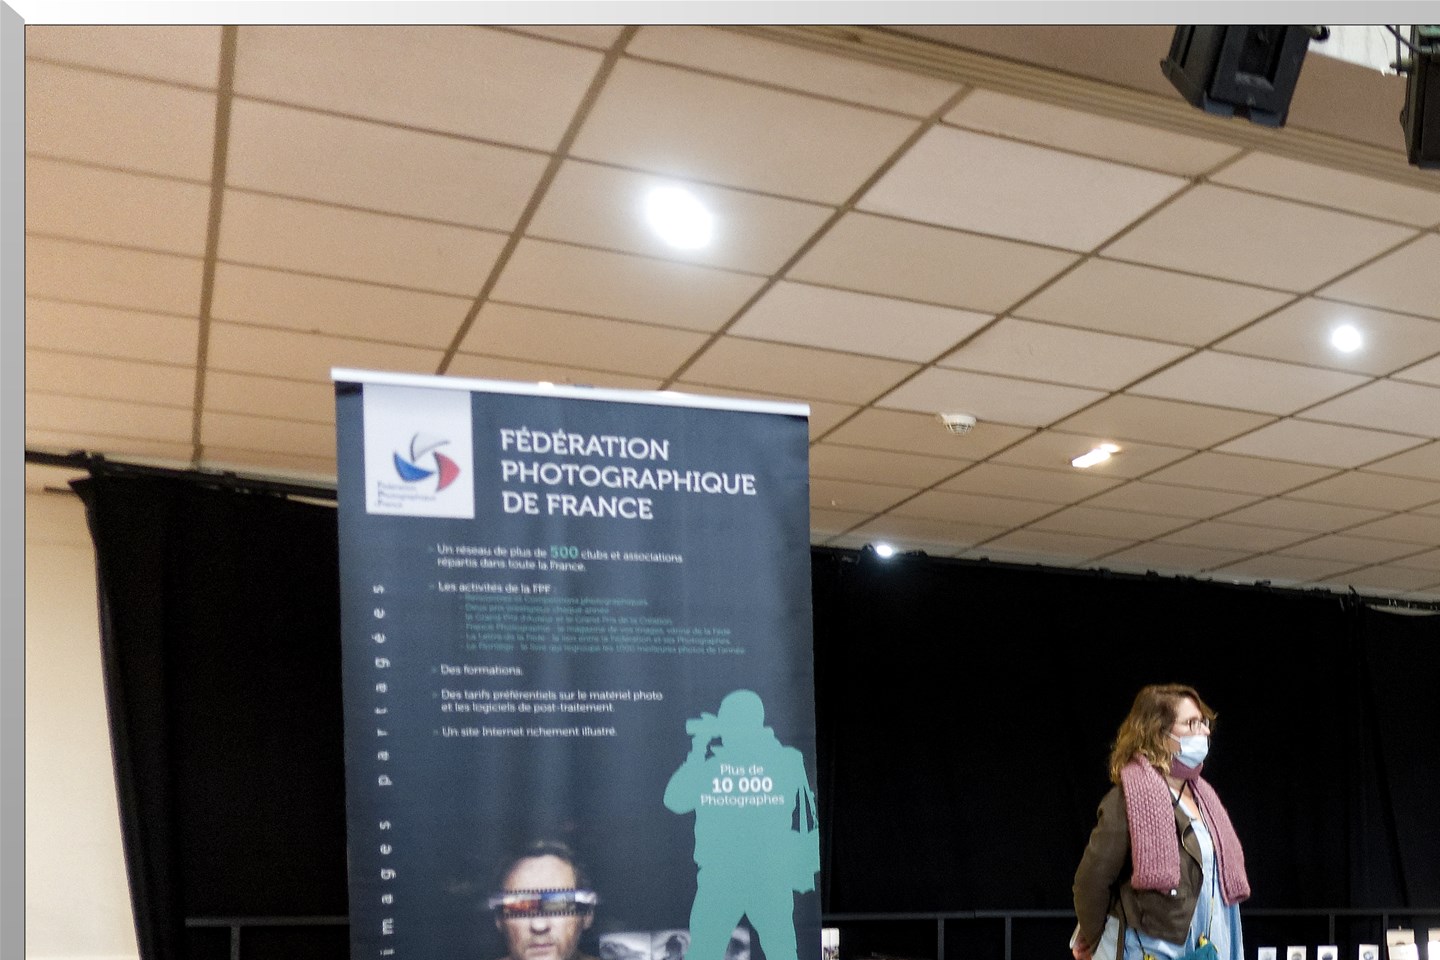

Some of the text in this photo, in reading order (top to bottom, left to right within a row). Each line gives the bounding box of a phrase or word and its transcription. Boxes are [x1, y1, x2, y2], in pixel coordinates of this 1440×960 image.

[500, 426, 670, 461] FÉDÉRATION
[501, 460, 757, 496] PHOTOGRAPHIQUE
[502, 490, 654, 520] DE FRANCE
[437, 543, 452, 555] Un
[494, 545, 508, 557] de
[509, 546, 534, 560] plus
[536, 547, 548, 559] de
[550, 545, 579, 560] 500
[581, 549, 608, 561] clubs
[610, 551, 622, 562] et
[623, 551, 683, 564] associations
[480, 558, 506, 569] dans
[508, 559, 536, 570] toute
[438, 581, 457, 592] Les
[505, 582, 518, 593] de
[520, 583, 531, 594] la
[440, 664, 461, 675] Des
[371, 584, 393, 787] partagées
[441, 689, 462, 700] Des
[464, 689, 490, 701] tarifs
[559, 692, 576, 701] sur
[577, 689, 587, 701] le
[633, 690, 663, 703] photo
[441, 703, 453, 713] et
[454, 702, 470, 713] les
[472, 702, 516, 715] logiciels
[517, 702, 532, 713] de
[442, 726, 458, 737] Un
[461, 726, 479, 737] site
[526, 726, 580, 737] richement
[720, 763, 764, 776] Plus de
[712, 776, 773, 793] 10 000
[700, 793, 785, 808] Photographes
[379, 820, 397, 957] images
